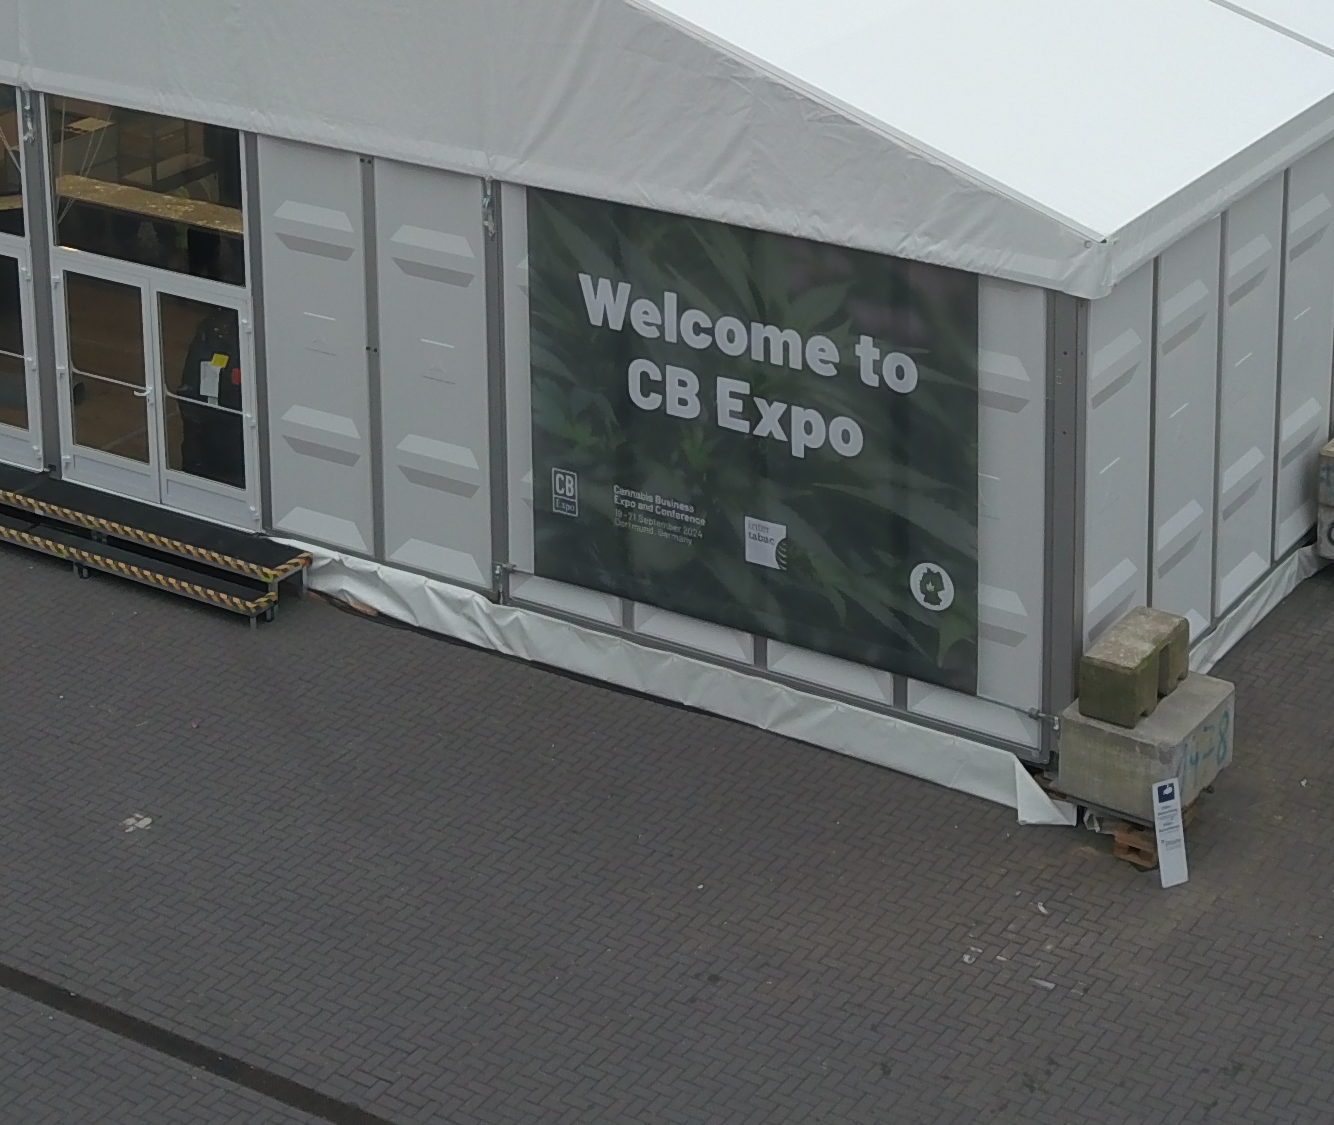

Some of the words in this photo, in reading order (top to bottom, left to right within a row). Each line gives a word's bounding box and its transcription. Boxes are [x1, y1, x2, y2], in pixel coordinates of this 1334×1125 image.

[578, 272, 840, 378] Welcome
[854, 334, 920, 395] to
[627, 358, 700, 420] CB
[715, 376, 865, 459] Expo
[555, 473, 574, 497] CB
[556, 499, 575, 512] Expo
[614, 495, 636, 508] Expo
[638, 503, 654, 513] and
[655, 505, 706, 526] Conference
[655, 495, 695, 513] Business
[748, 531, 775, 545] tabac
